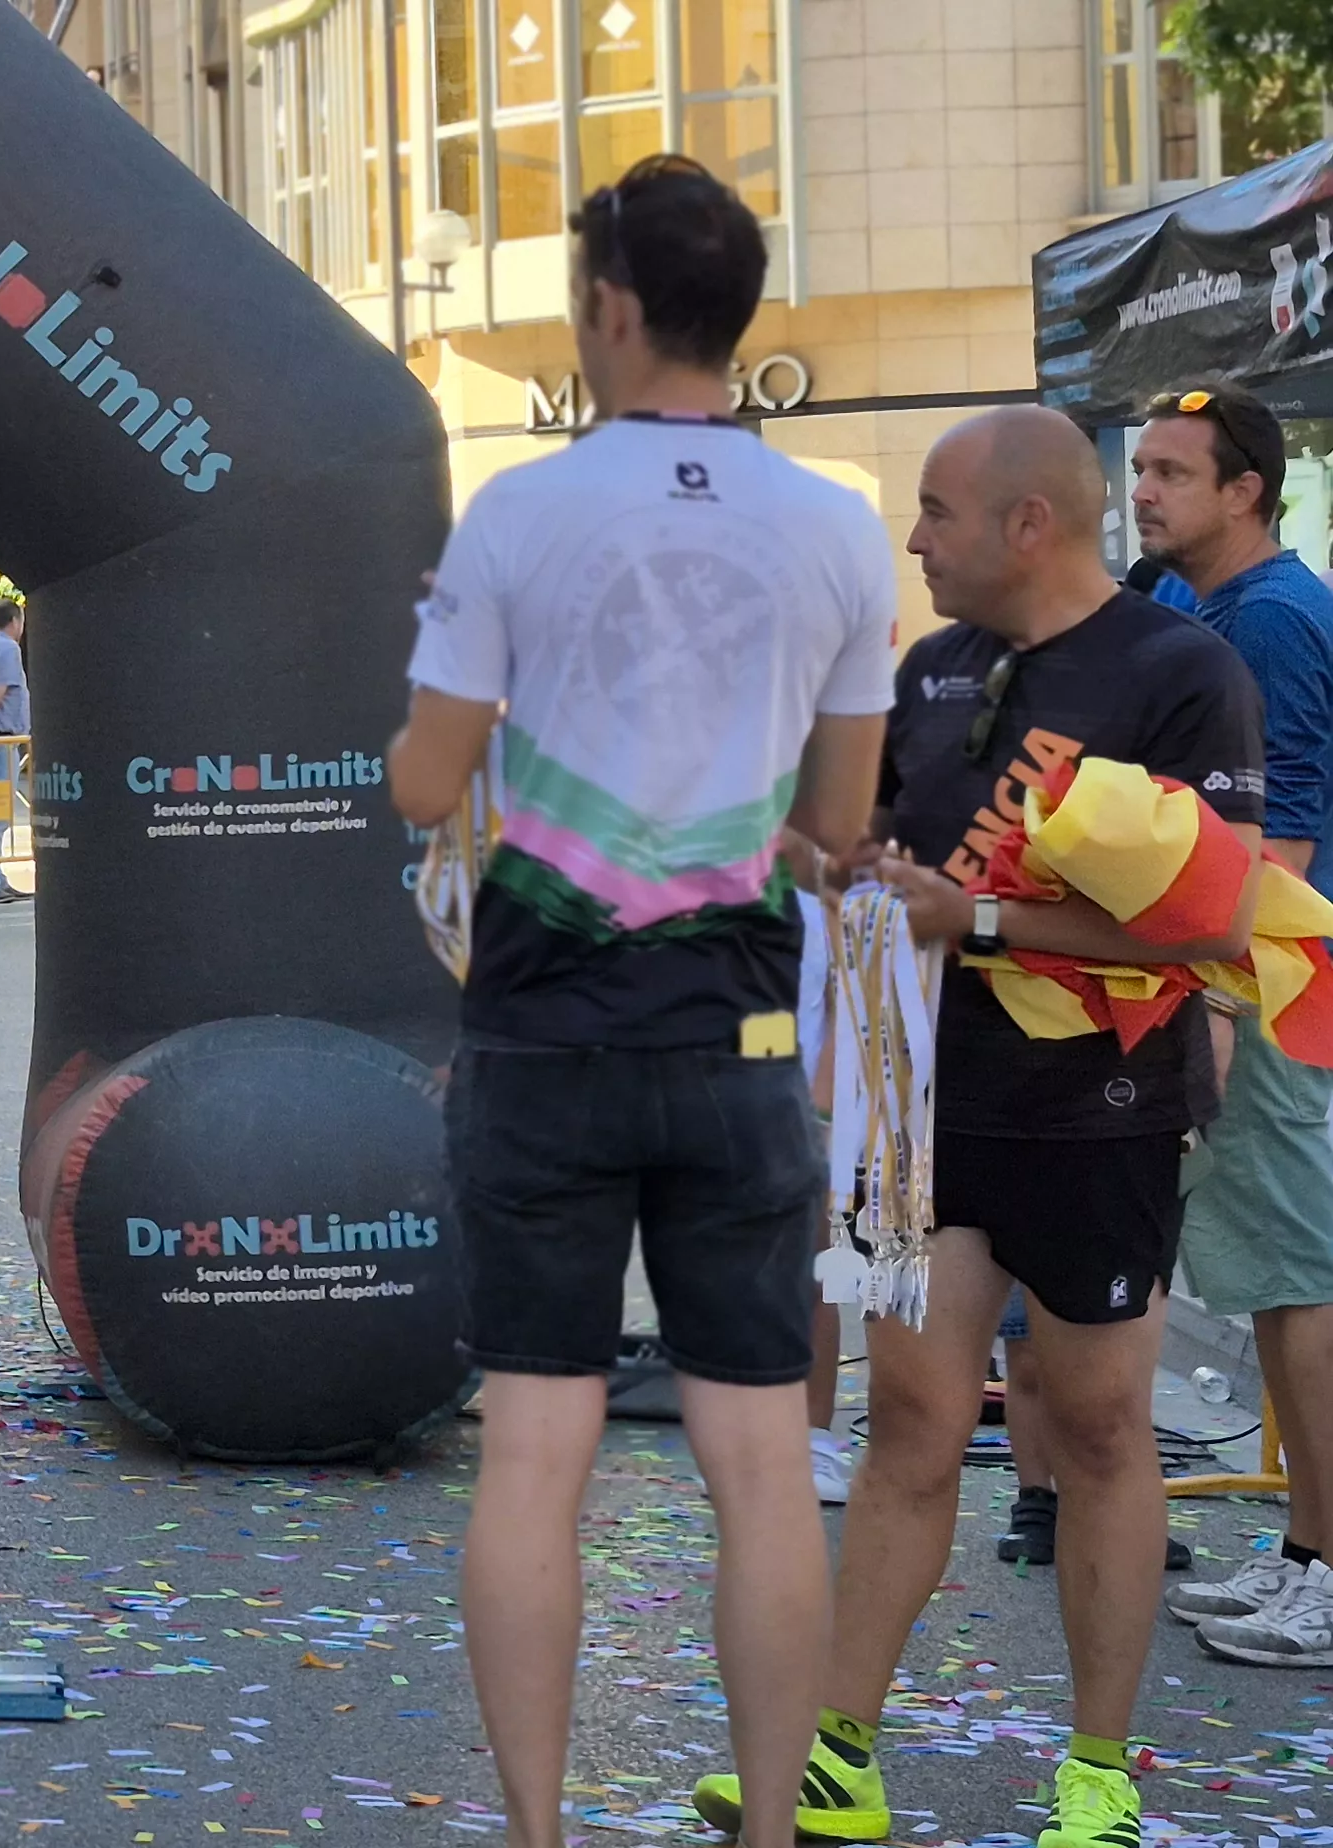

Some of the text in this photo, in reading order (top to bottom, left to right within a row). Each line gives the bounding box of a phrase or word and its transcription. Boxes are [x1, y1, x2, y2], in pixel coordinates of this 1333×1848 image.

[152, 798, 352, 817] Servicio de cronometraje y
[146, 816, 368, 839] gestión de eventos deportivos
[195, 1265, 264, 1283] Servicio
[266, 1263, 290, 1281] de
[364, 1263, 378, 1280] y
[213, 1282, 326, 1306] promocional
[328, 1279, 415, 1302] deportivo
